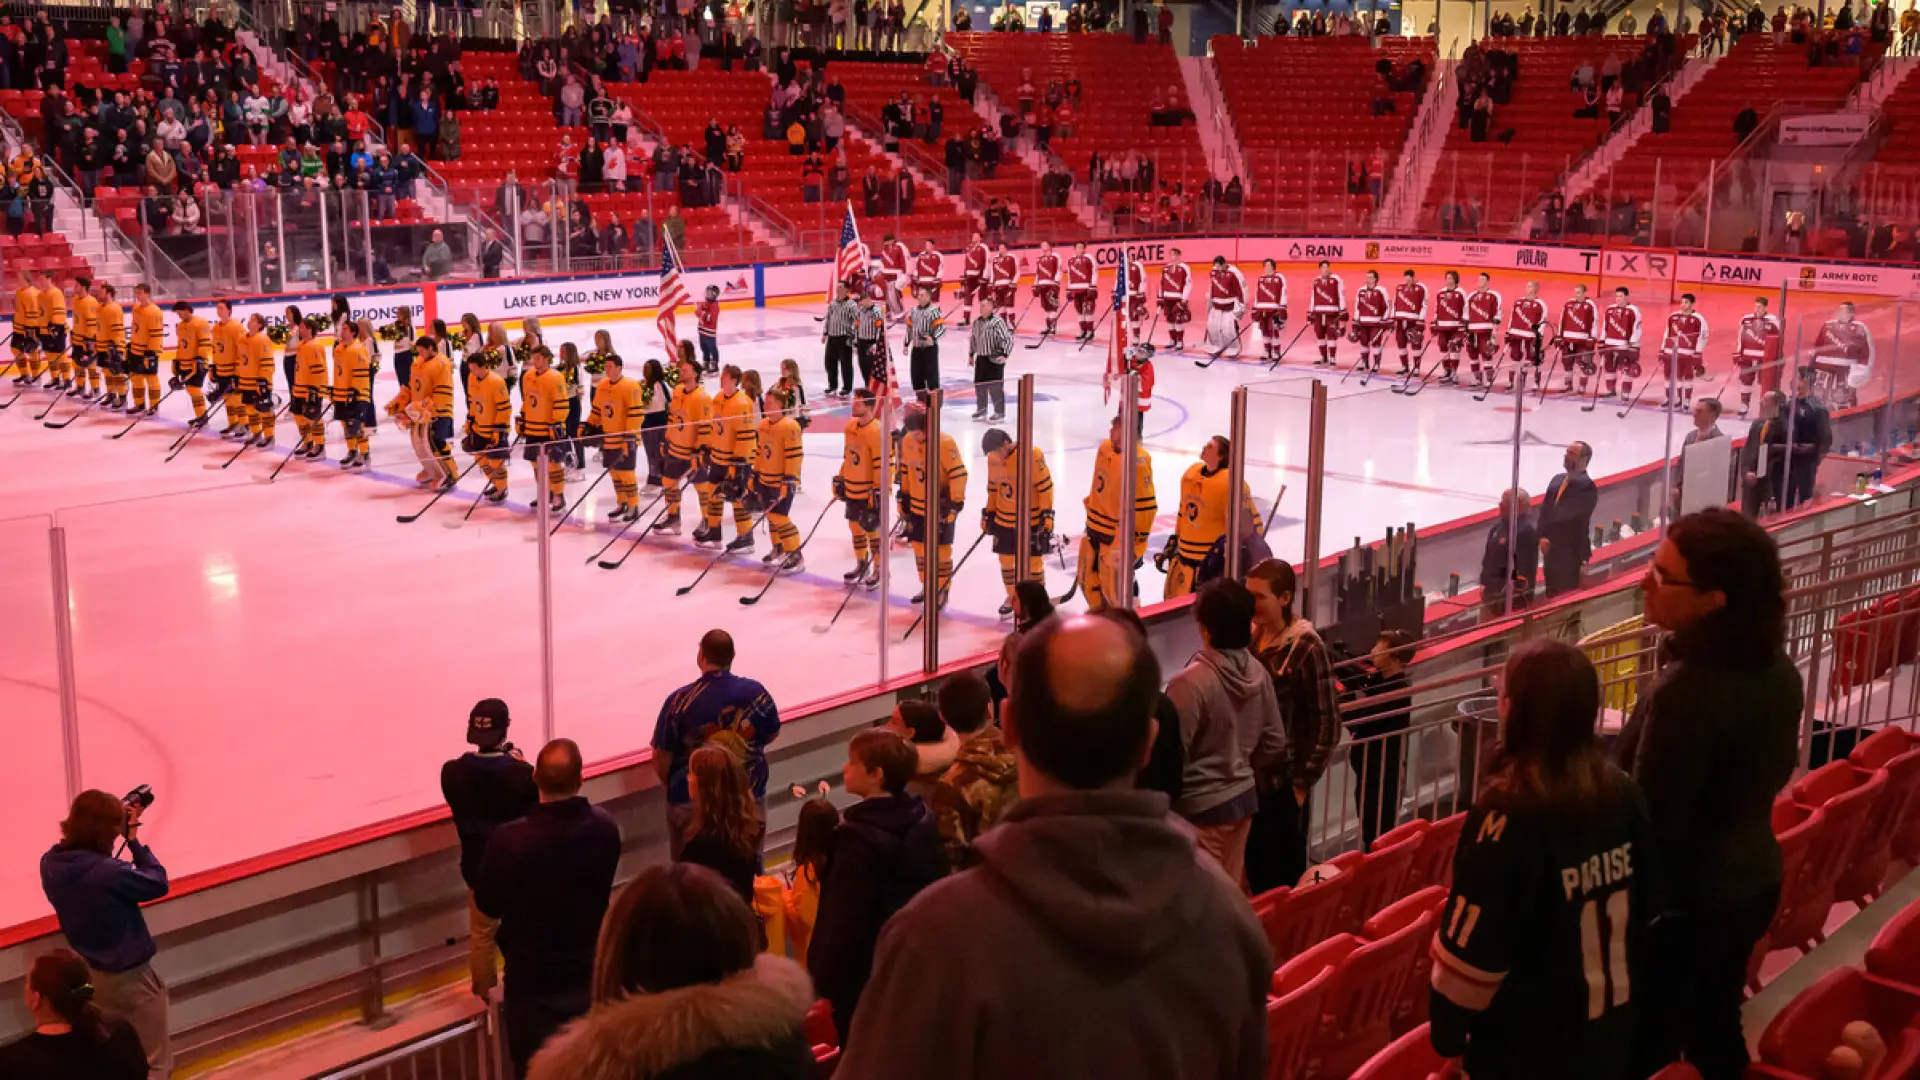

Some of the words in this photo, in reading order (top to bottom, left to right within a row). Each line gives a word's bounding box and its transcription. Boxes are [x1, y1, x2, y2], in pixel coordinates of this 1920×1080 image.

[1305, 244, 1343, 257] RAIN
[1384, 245, 1408, 253] ARMY
[1410, 246, 1432, 254] ROTC
[1516, 249, 1549, 269] POLAR
[1580, 252, 1668, 277] TIXR
[1719, 265, 1762, 281] RAIN
[1821, 272, 1850, 281] ARMY
[1852, 273, 1878, 283] ROTC
[504, 295, 536, 309] LAKE
[541, 291, 590, 306] PLACID,
[593, 288, 621, 302] NEW
[624, 286, 659, 299] YORK
[1447, 895, 1481, 949] 11
[1580, 889, 1630, 1021] 11
